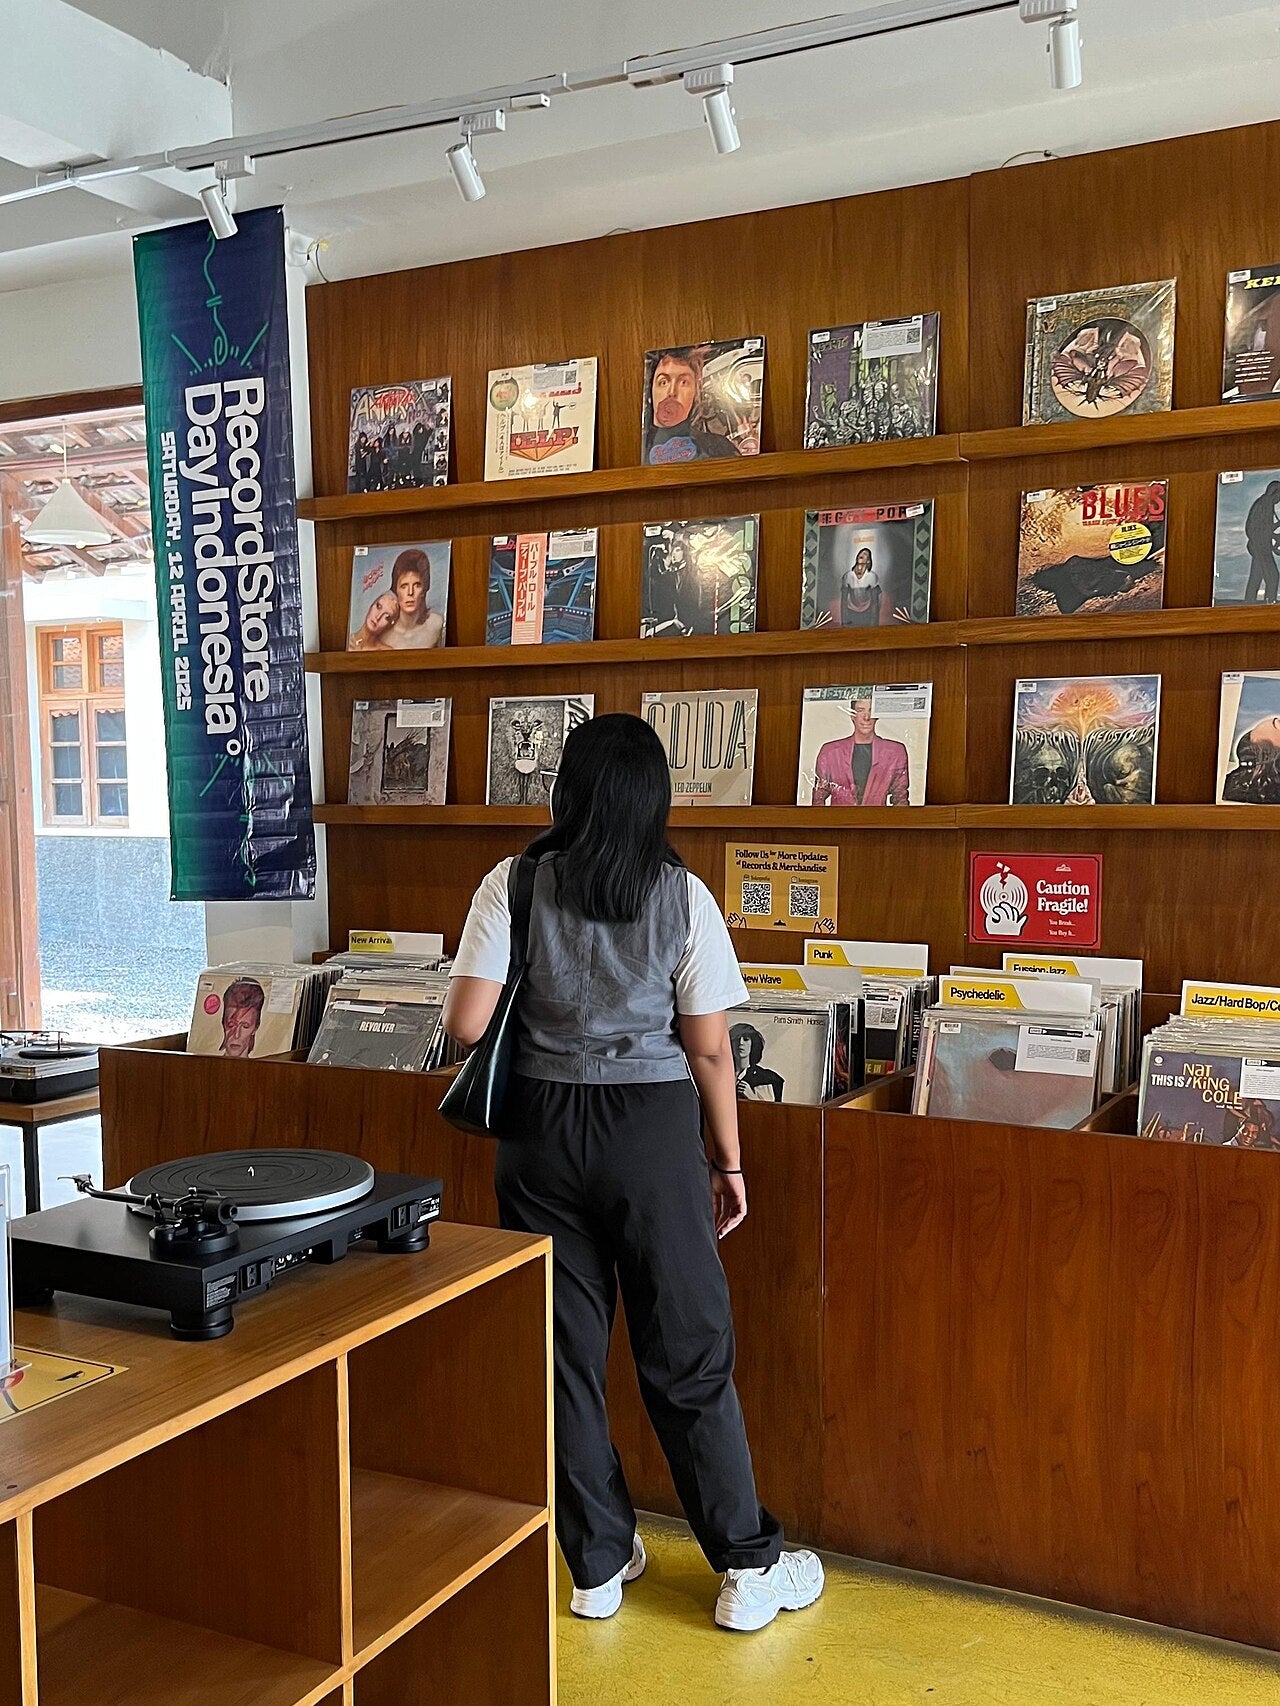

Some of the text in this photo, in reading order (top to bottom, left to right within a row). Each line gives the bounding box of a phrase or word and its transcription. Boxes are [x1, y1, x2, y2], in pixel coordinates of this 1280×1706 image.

[1082, 484, 1165, 520] BLUES
[160, 431, 192, 711] SATURDAY, 12 APRIL 2025
[735, 849, 760, 859] Follow
[760, 850, 769, 859] Us
[777, 851, 797, 860] More
[798, 852, 828, 862] Updates
[741, 860, 771, 871] Records
[772, 862, 779, 870] &
[779, 862, 827, 873] Merchandise
[1036, 879, 1090, 896] Caution
[1038, 897, 1088, 915] Fragile!
[351, 936, 367, 944] New
[813, 949, 833, 960] Punk
[760, 974, 782, 985] Wave
[950, 986, 1006, 1001] Psychedelic
[359, 1021, 396, 1033] REVOLVER
[1151, 1074, 1174, 1087] THIS
[1202, 1090, 1243, 1105] COLE
